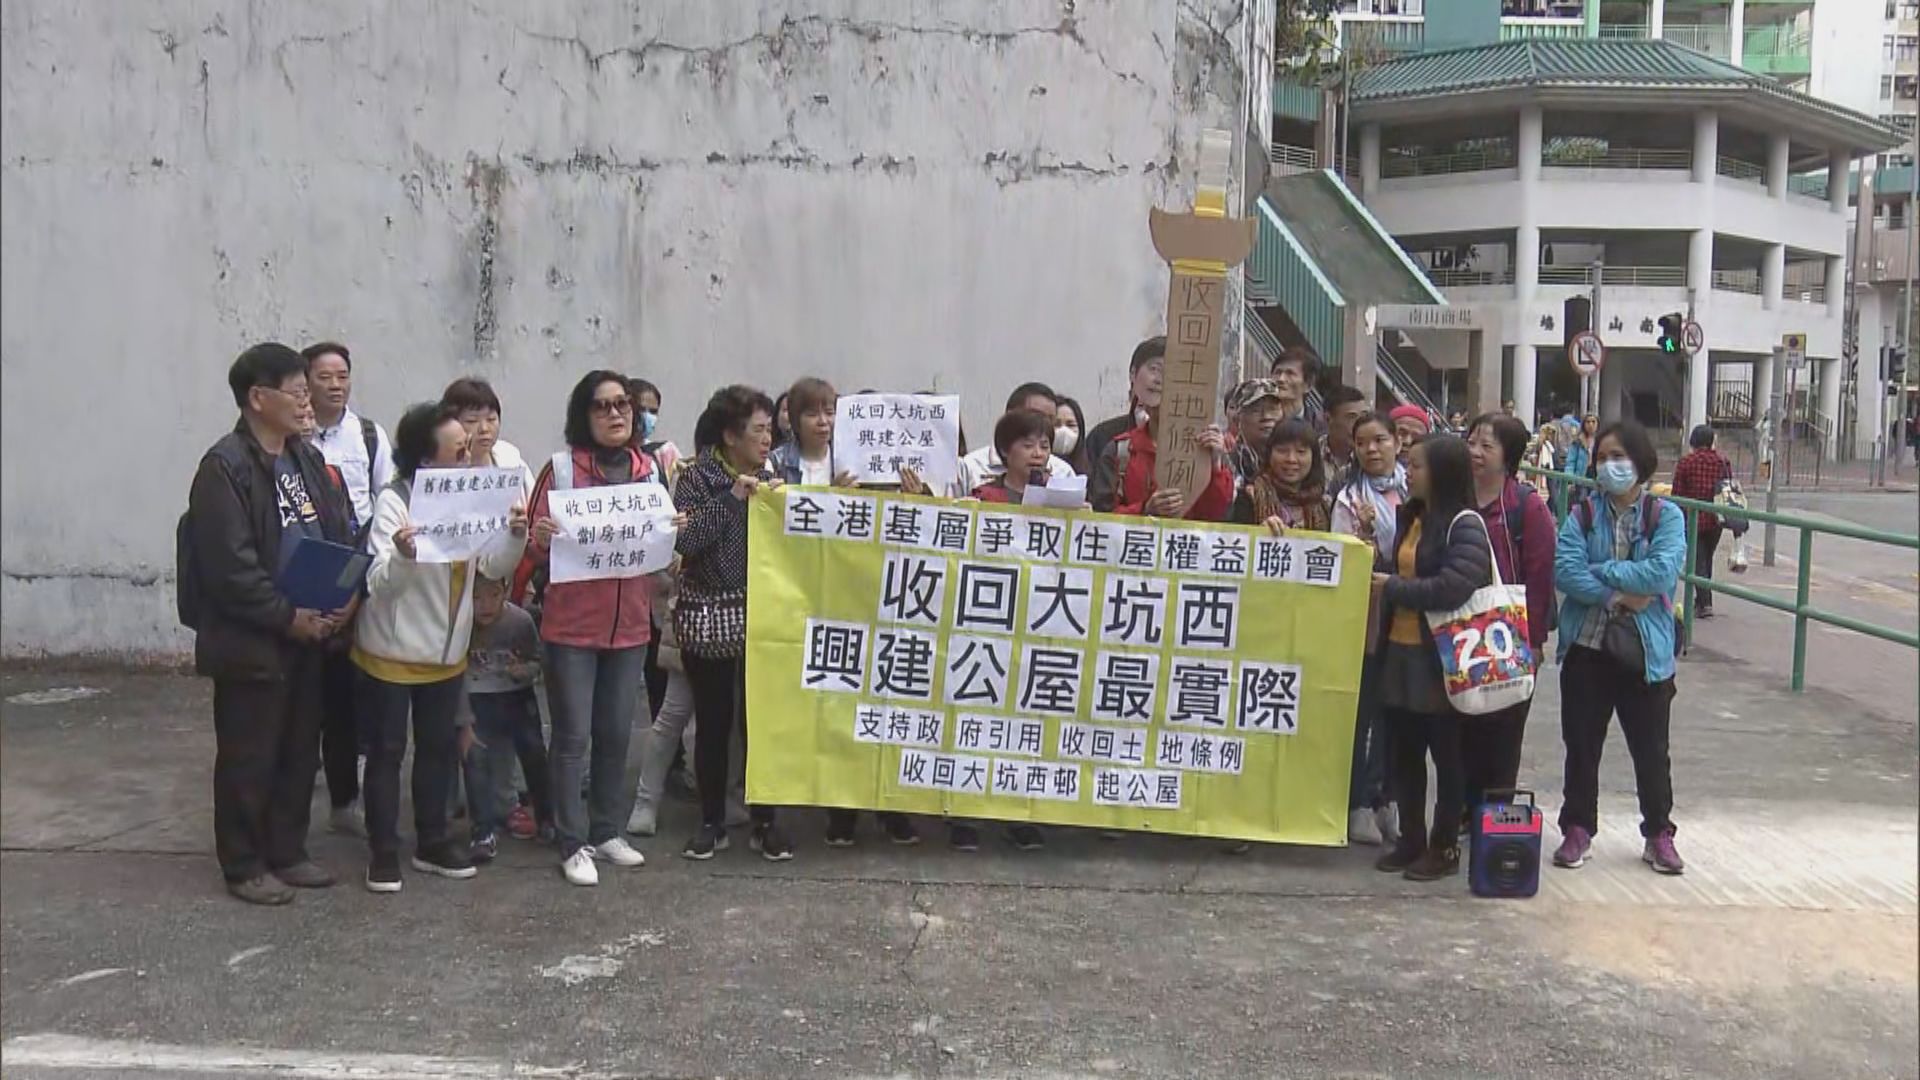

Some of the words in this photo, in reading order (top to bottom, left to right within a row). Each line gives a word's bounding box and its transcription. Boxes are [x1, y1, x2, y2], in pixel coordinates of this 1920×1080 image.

[1164, 278, 1216, 492] 收回土地條例
[848, 403, 946, 421] 收回大坑西
[858, 428, 935, 447] 興建公屋
[868, 454, 925, 473] 最實際
[565, 493, 662, 517] 收回大坑西
[787, 496, 1338, 581] 全港基層爭取住屋權益聯會
[586, 550, 645, 569] 有依歸
[882, 555, 1235, 648] 收回大坑西
[1453, 619, 1513, 671] 20
[805, 622, 1299, 731] 興建公屋最實際
